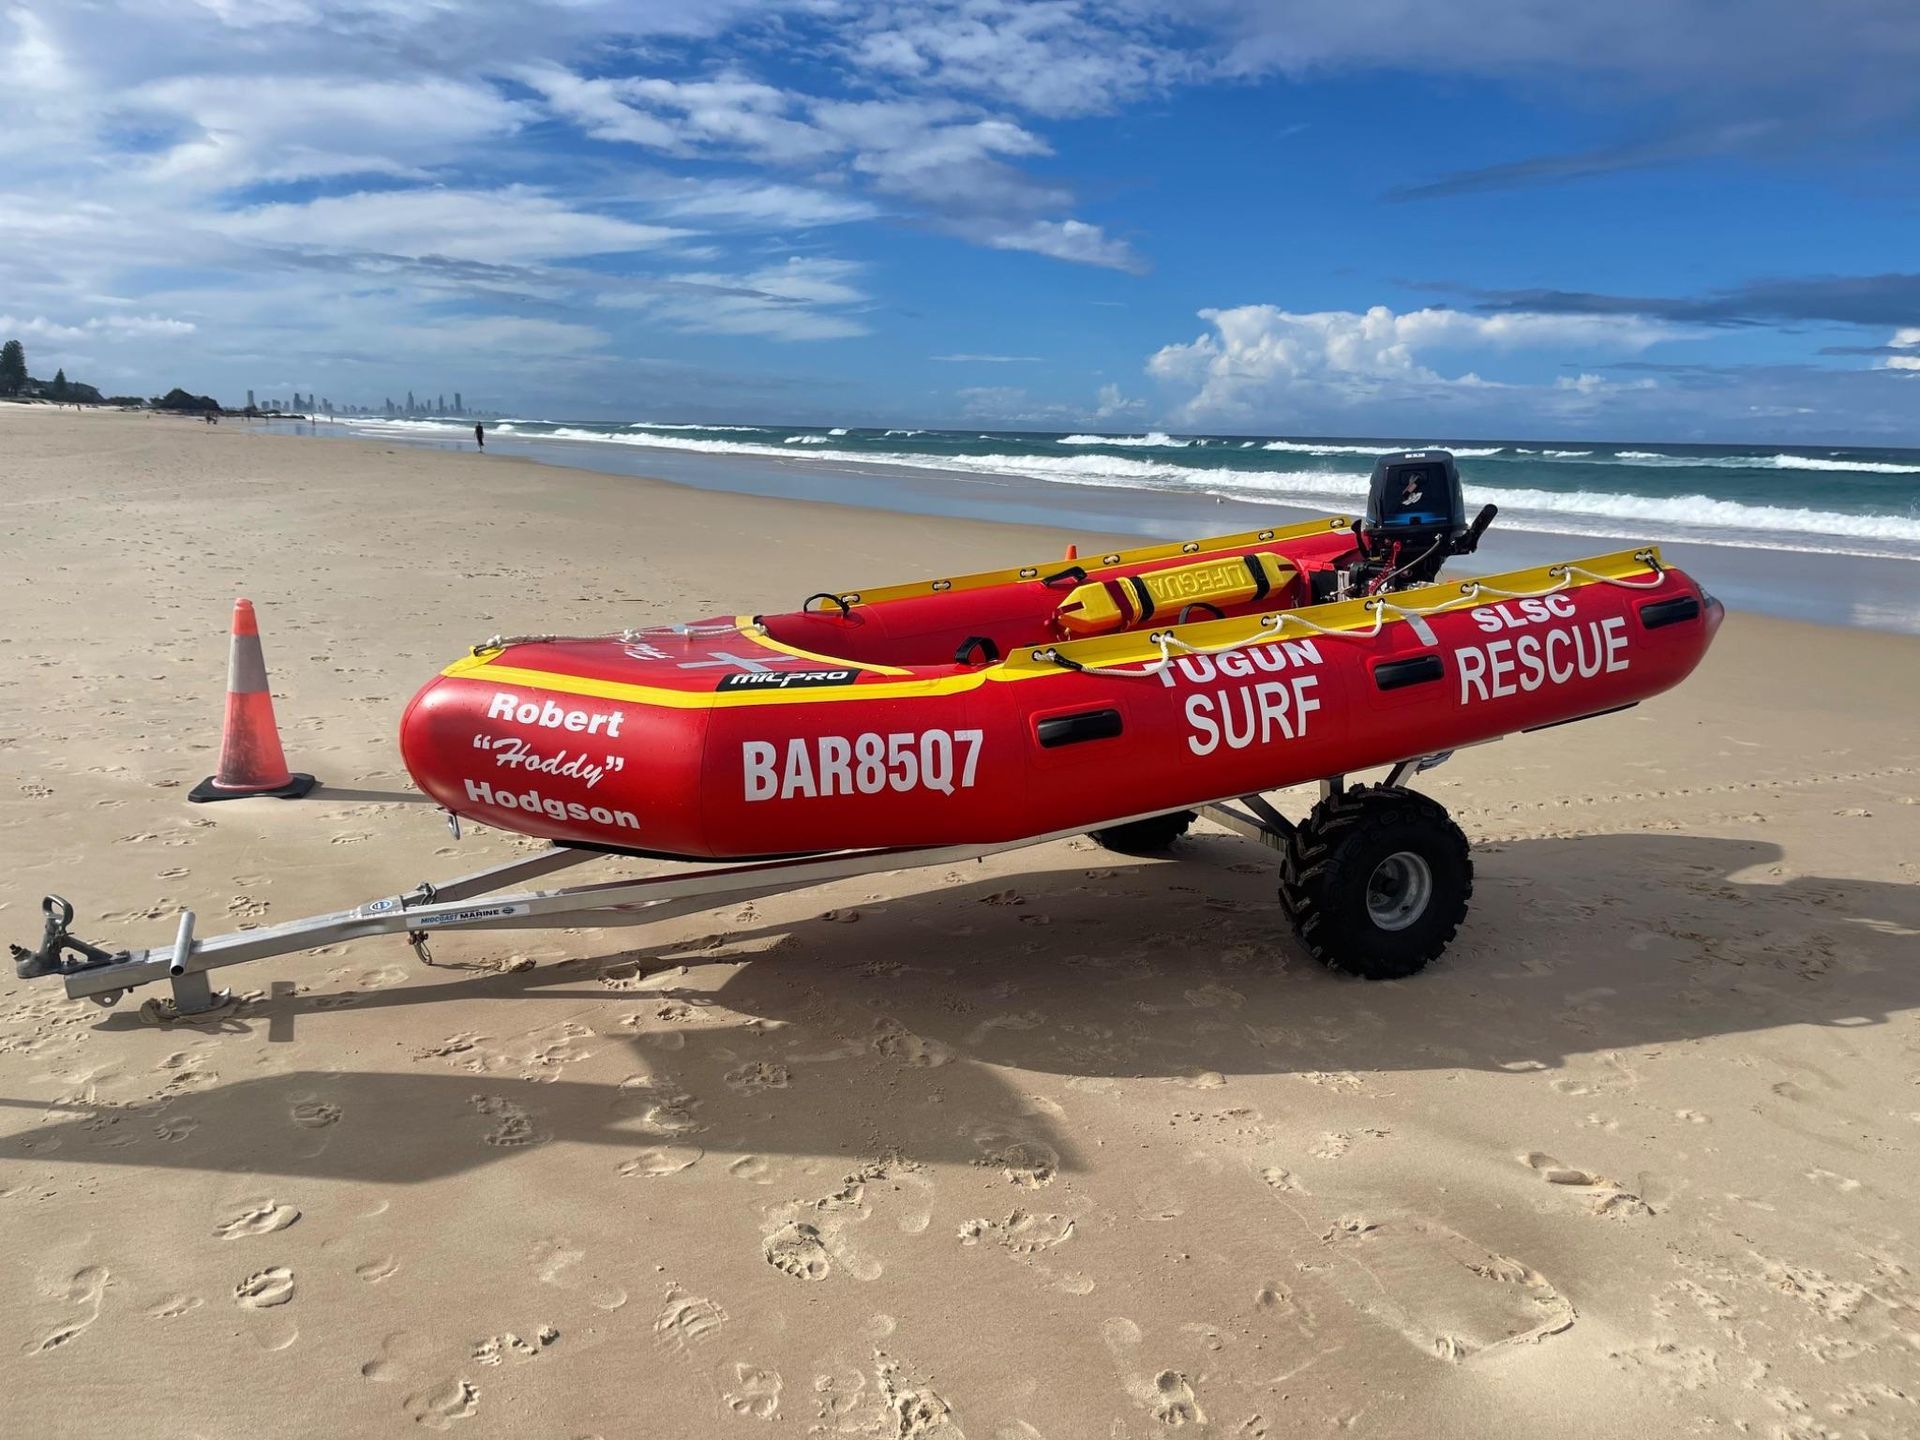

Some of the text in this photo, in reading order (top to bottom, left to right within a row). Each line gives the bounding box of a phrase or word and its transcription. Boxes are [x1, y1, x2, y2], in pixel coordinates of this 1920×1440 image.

[1147, 564, 1246, 598] LIFEGUA
[1471, 594, 1576, 632] SLSC
[1143, 639, 1324, 688] TUGUN
[1455, 616, 1630, 705] RESCUE
[487, 693, 624, 738] Robert
[1185, 675, 1321, 756] SURF
[743, 729, 983, 802] BAR85Q7
[464, 778, 640, 830] Hodgson
[460, 909, 500, 919] MARINE
